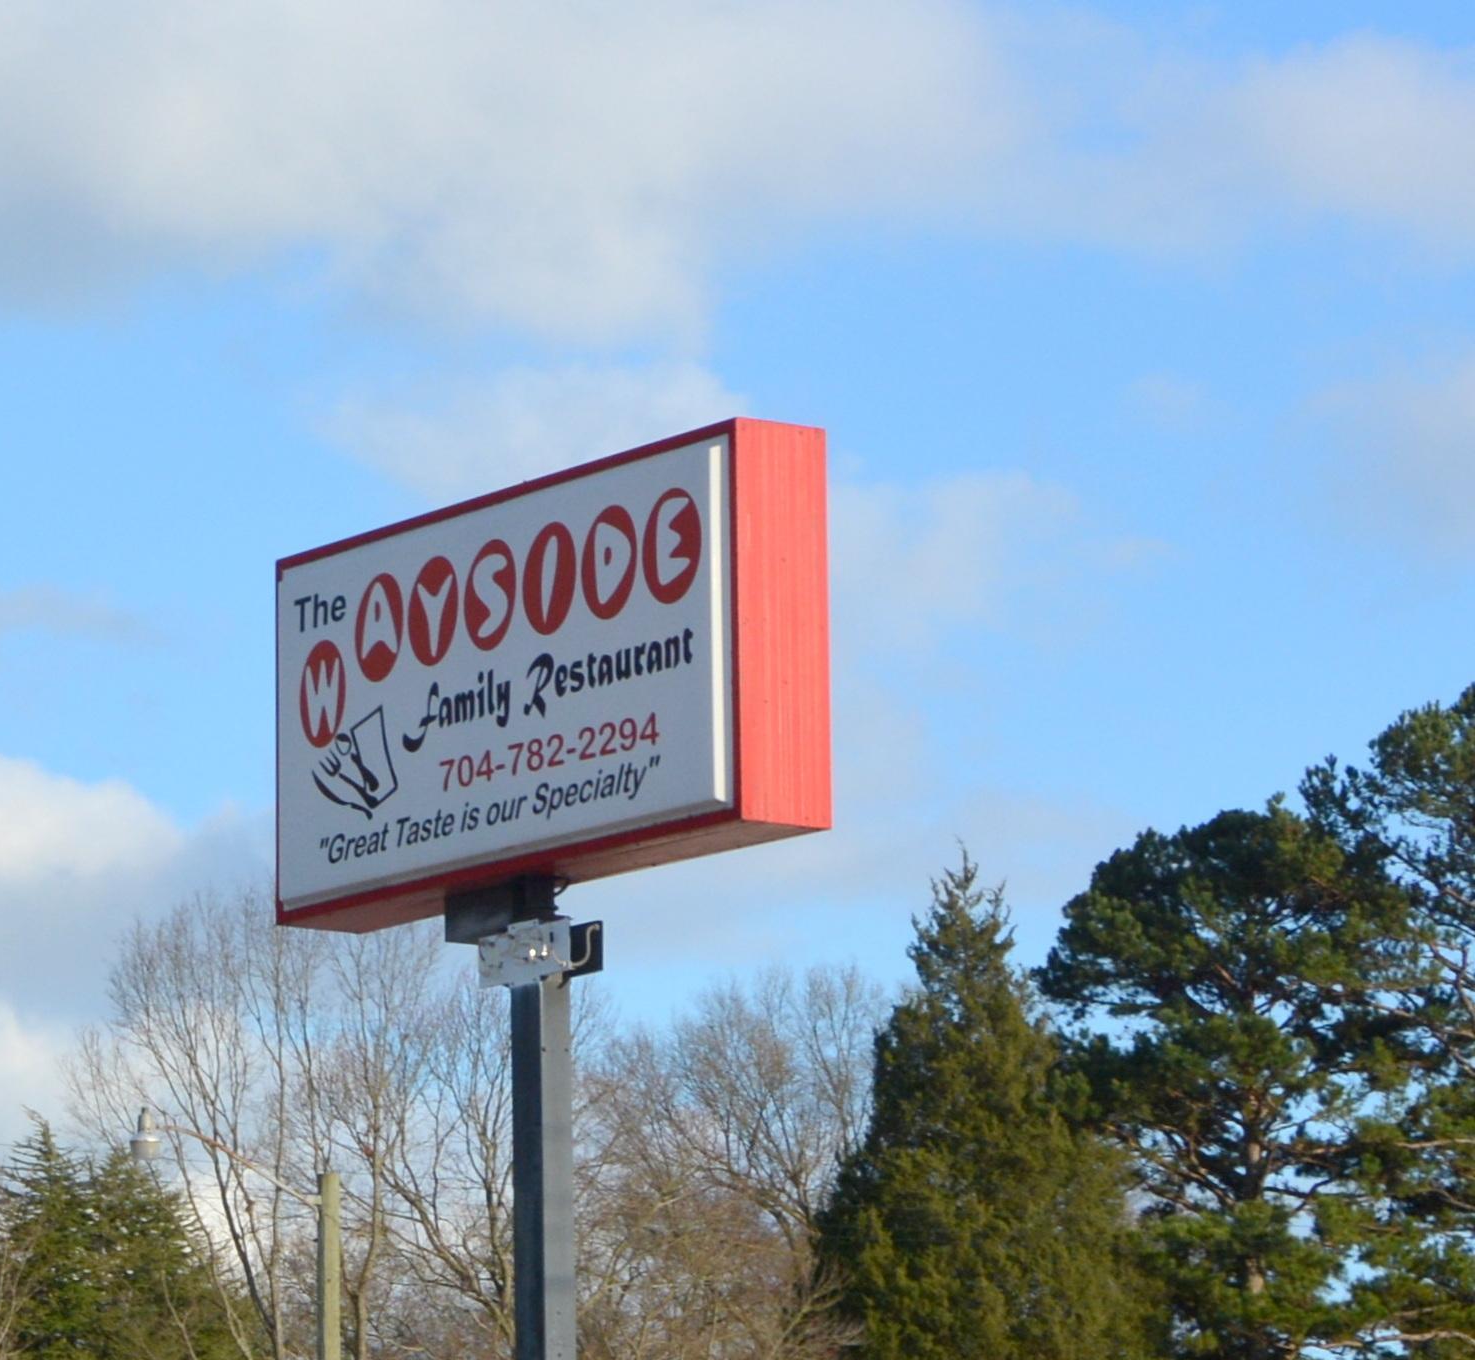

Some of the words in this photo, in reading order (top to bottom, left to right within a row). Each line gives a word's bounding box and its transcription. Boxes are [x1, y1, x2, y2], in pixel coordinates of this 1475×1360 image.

[295, 593, 347, 633] The
[300, 488, 702, 748] WAYSIDE
[402, 672, 511, 753] Family
[524, 627, 694, 719] Restaurant
[439, 712, 660, 792] 704-782-2294
[320, 820, 388, 864] "Great
[395, 806, 453, 848] Taste
[460, 803, 480, 833] is
[487, 797, 527, 824] our
[532, 755, 660, 815] Specialty"
